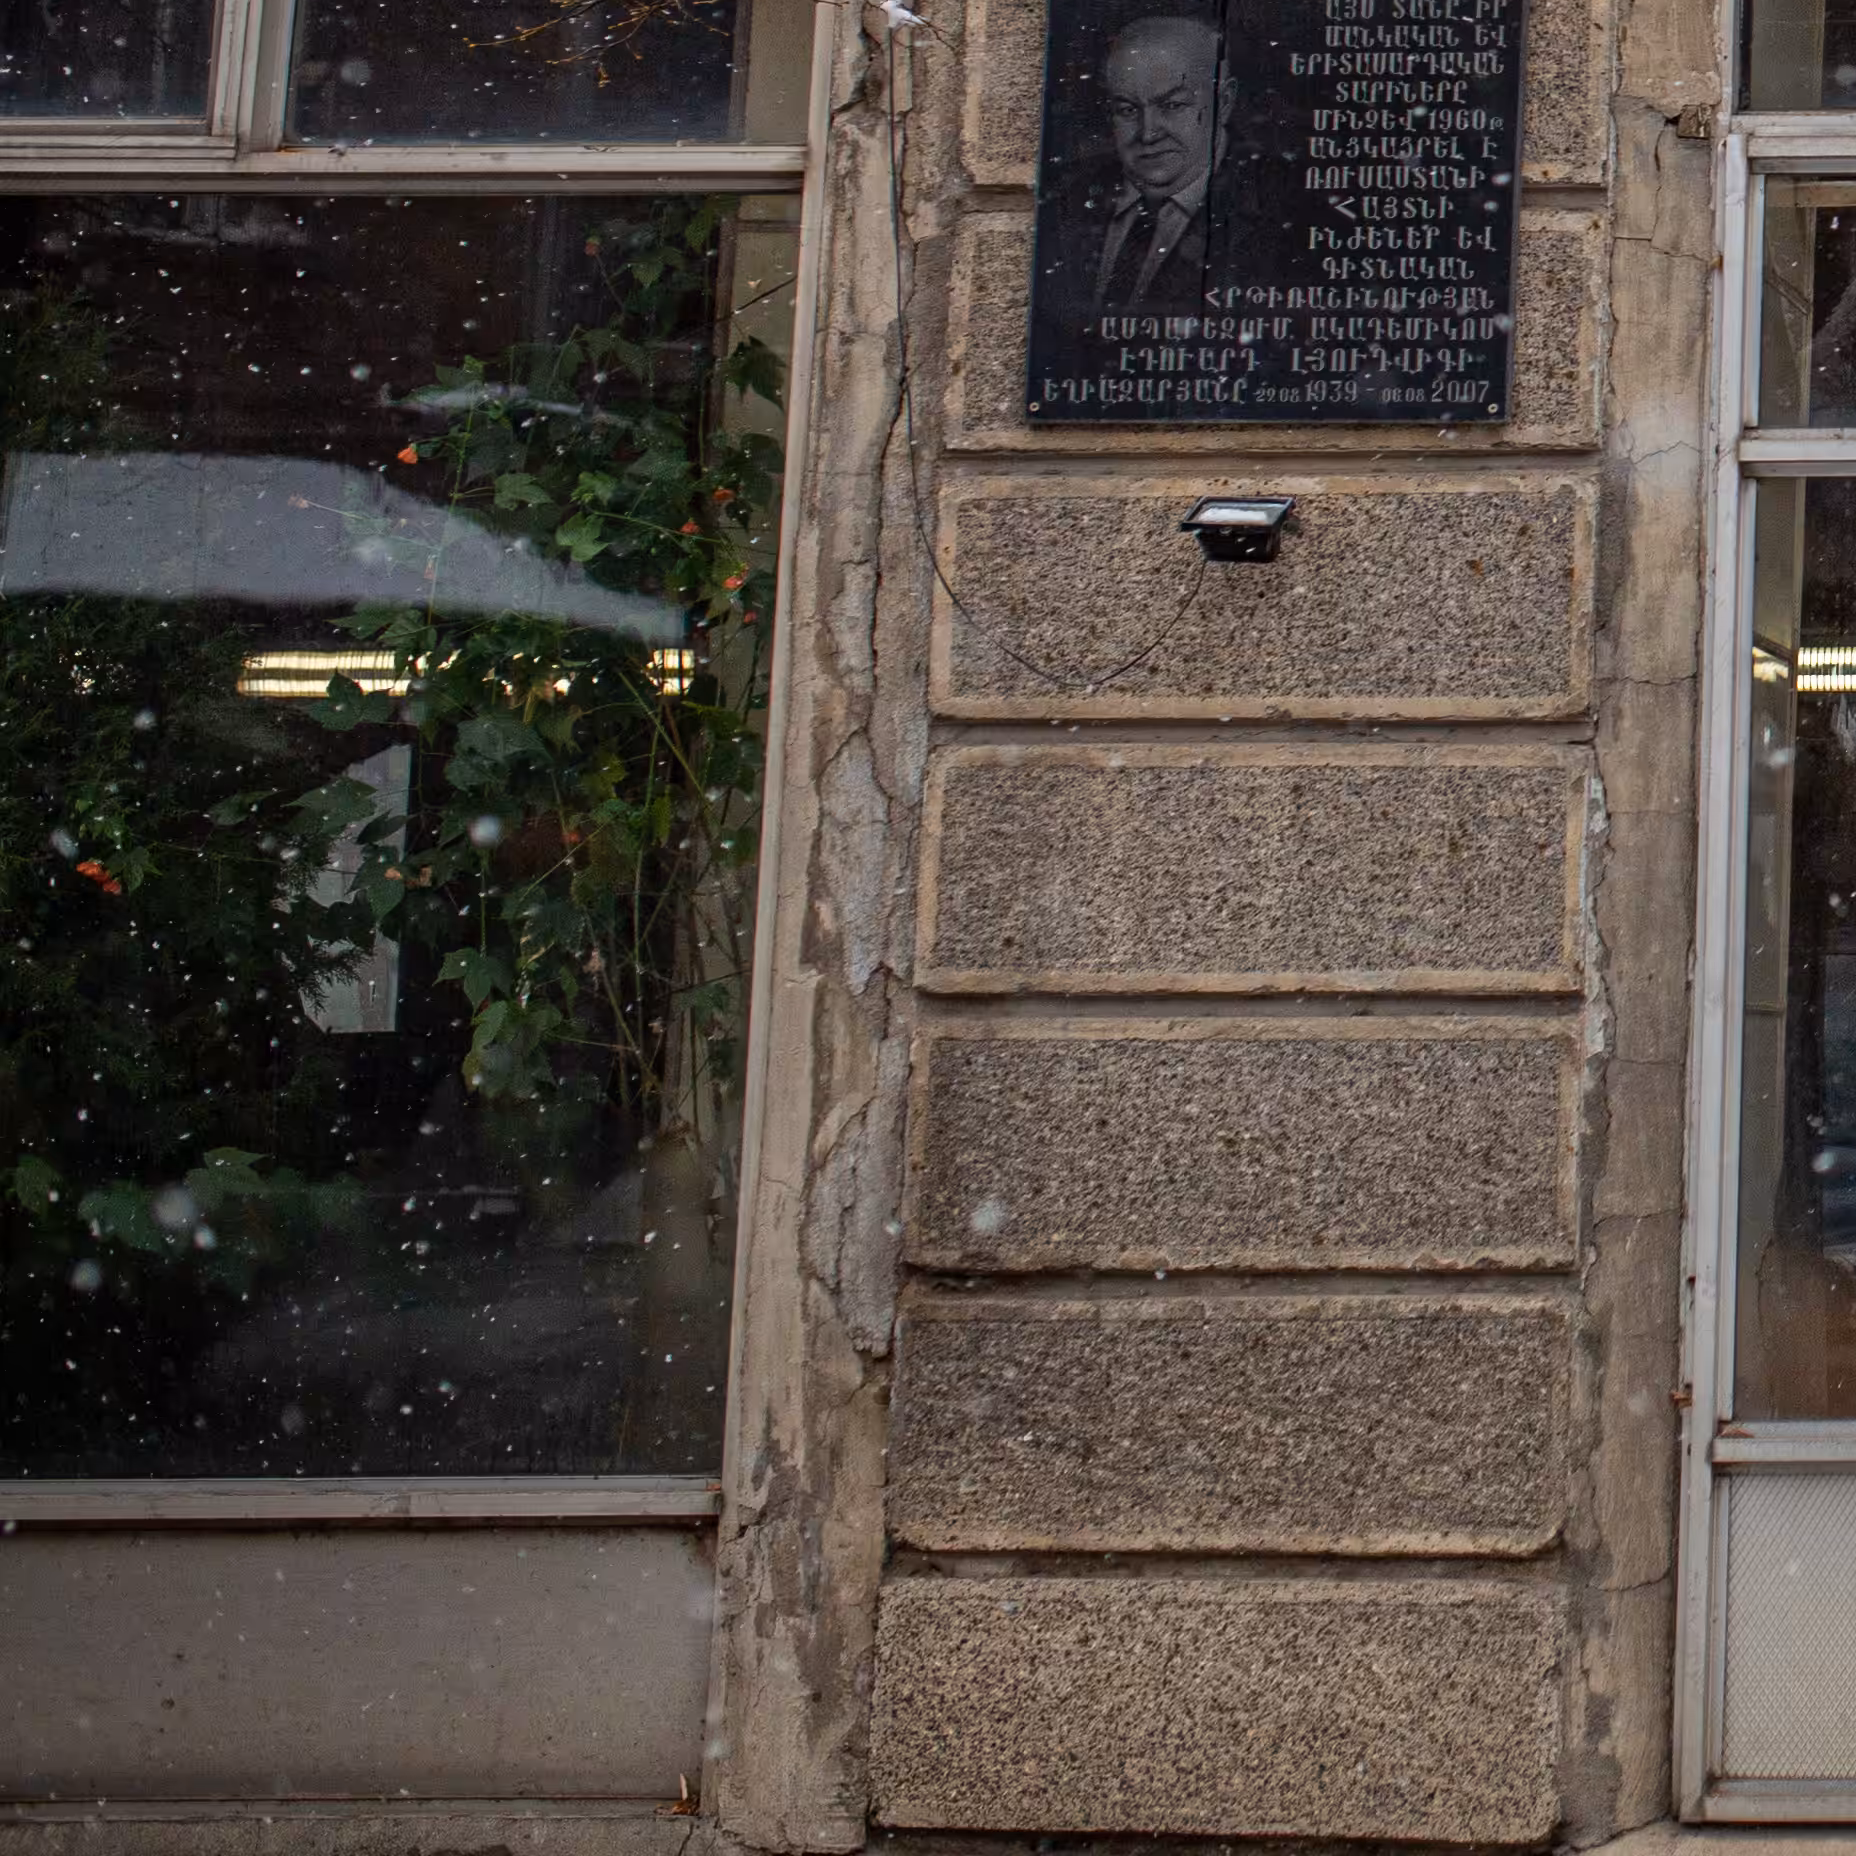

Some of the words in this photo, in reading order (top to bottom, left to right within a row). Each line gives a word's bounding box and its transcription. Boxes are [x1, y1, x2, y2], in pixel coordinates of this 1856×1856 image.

[1325, 25, 1460, 49] ՄԱՆԿԱԿԱՆ
[1475, 25, 1507, 48] ԵՎ
[1290, 52, 1505, 76] ԵՐԻՏԱՍԱՐԴԱԿԱՆ
[1336, 81, 1468, 104] ՏԱՐԻՆԵՐԸ
[1482, 136, 1497, 160] Է
[1305, 165, 1486, 190] ՌՈՒՍԱՍՏԱՆԻ
[1335, 196, 1454, 221] ՀԱՅՏՆԻ
[1308, 226, 1440, 251] ԻՆԺԵՆԵՐ
[1458, 226, 1497, 252] ԵՎ
[1322, 256, 1475, 281] ԳԻՏՆԱԿԱՆ
[1311, 316, 1495, 341] ԱԿԱԴԵՄԻԿՈՍ
[1120, 347, 1261, 374] ԷԴՈՒԱՐԴ
